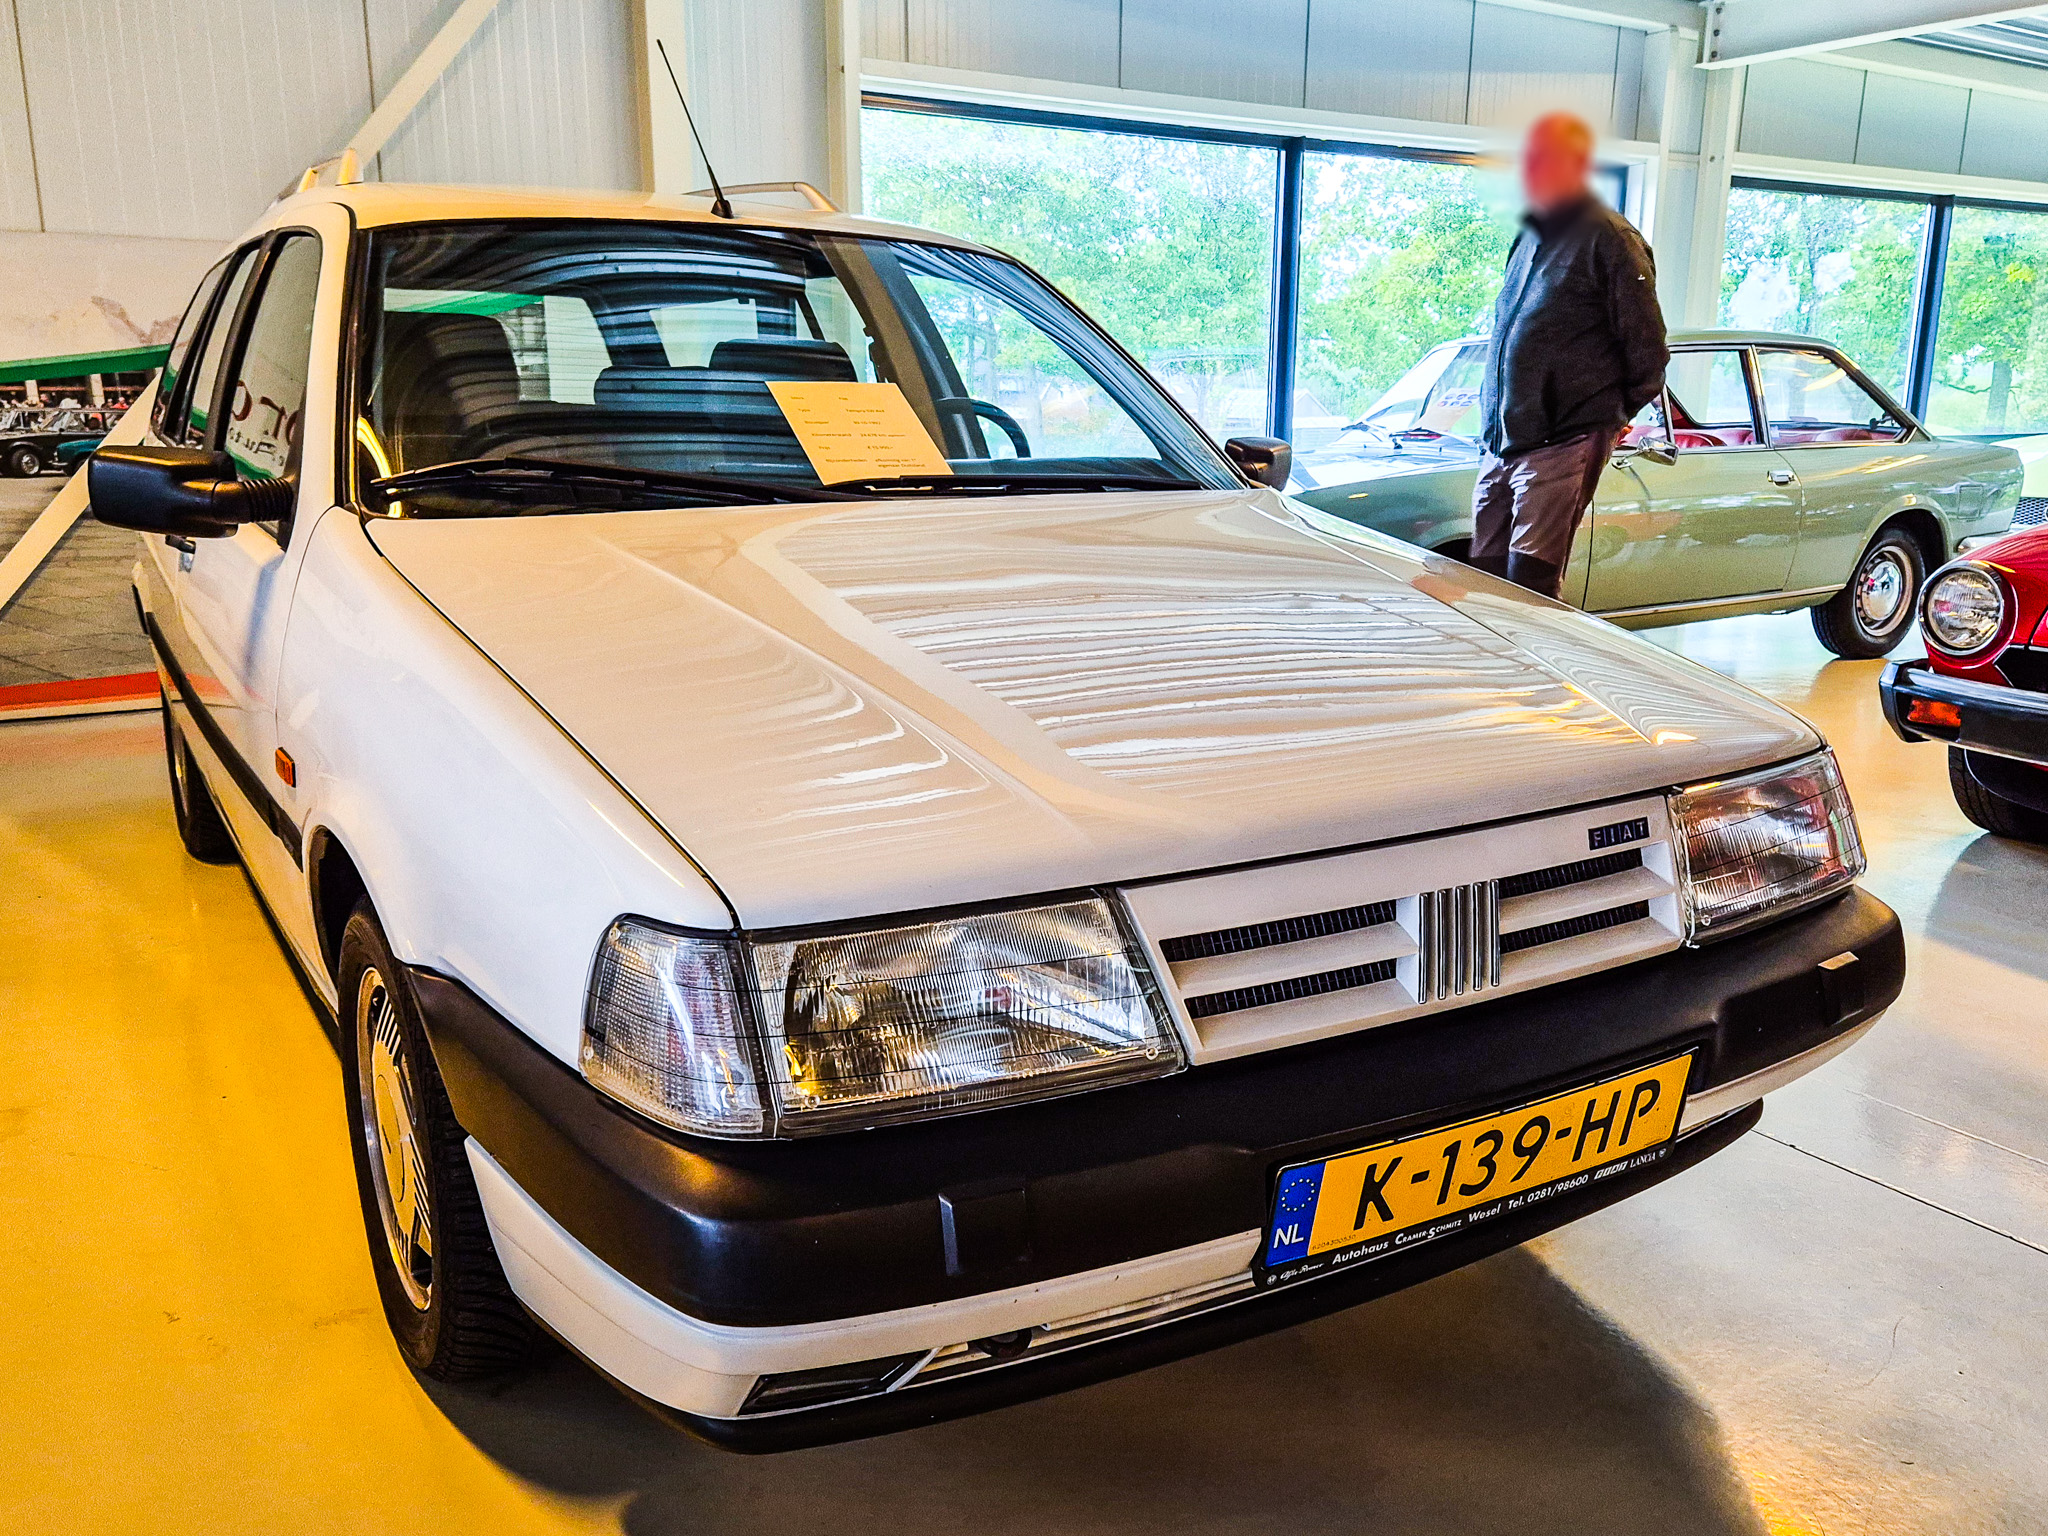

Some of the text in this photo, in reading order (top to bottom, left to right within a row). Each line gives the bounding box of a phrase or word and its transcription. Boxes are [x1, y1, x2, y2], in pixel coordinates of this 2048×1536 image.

[1593, 821, 1645, 847] FIAT
[1353, 1079, 1661, 1231] K-139-HP
[1630, 1151, 1656, 1169] LANCIA
[1332, 1241, 1389, 1265] Autohaus
[1468, 1203, 1502, 1222] Wesel
[1508, 1195, 1525, 1210] Tel.
[1527, 1174, 1589, 1203] 0281/98600
[1273, 1223, 1304, 1249] NL
